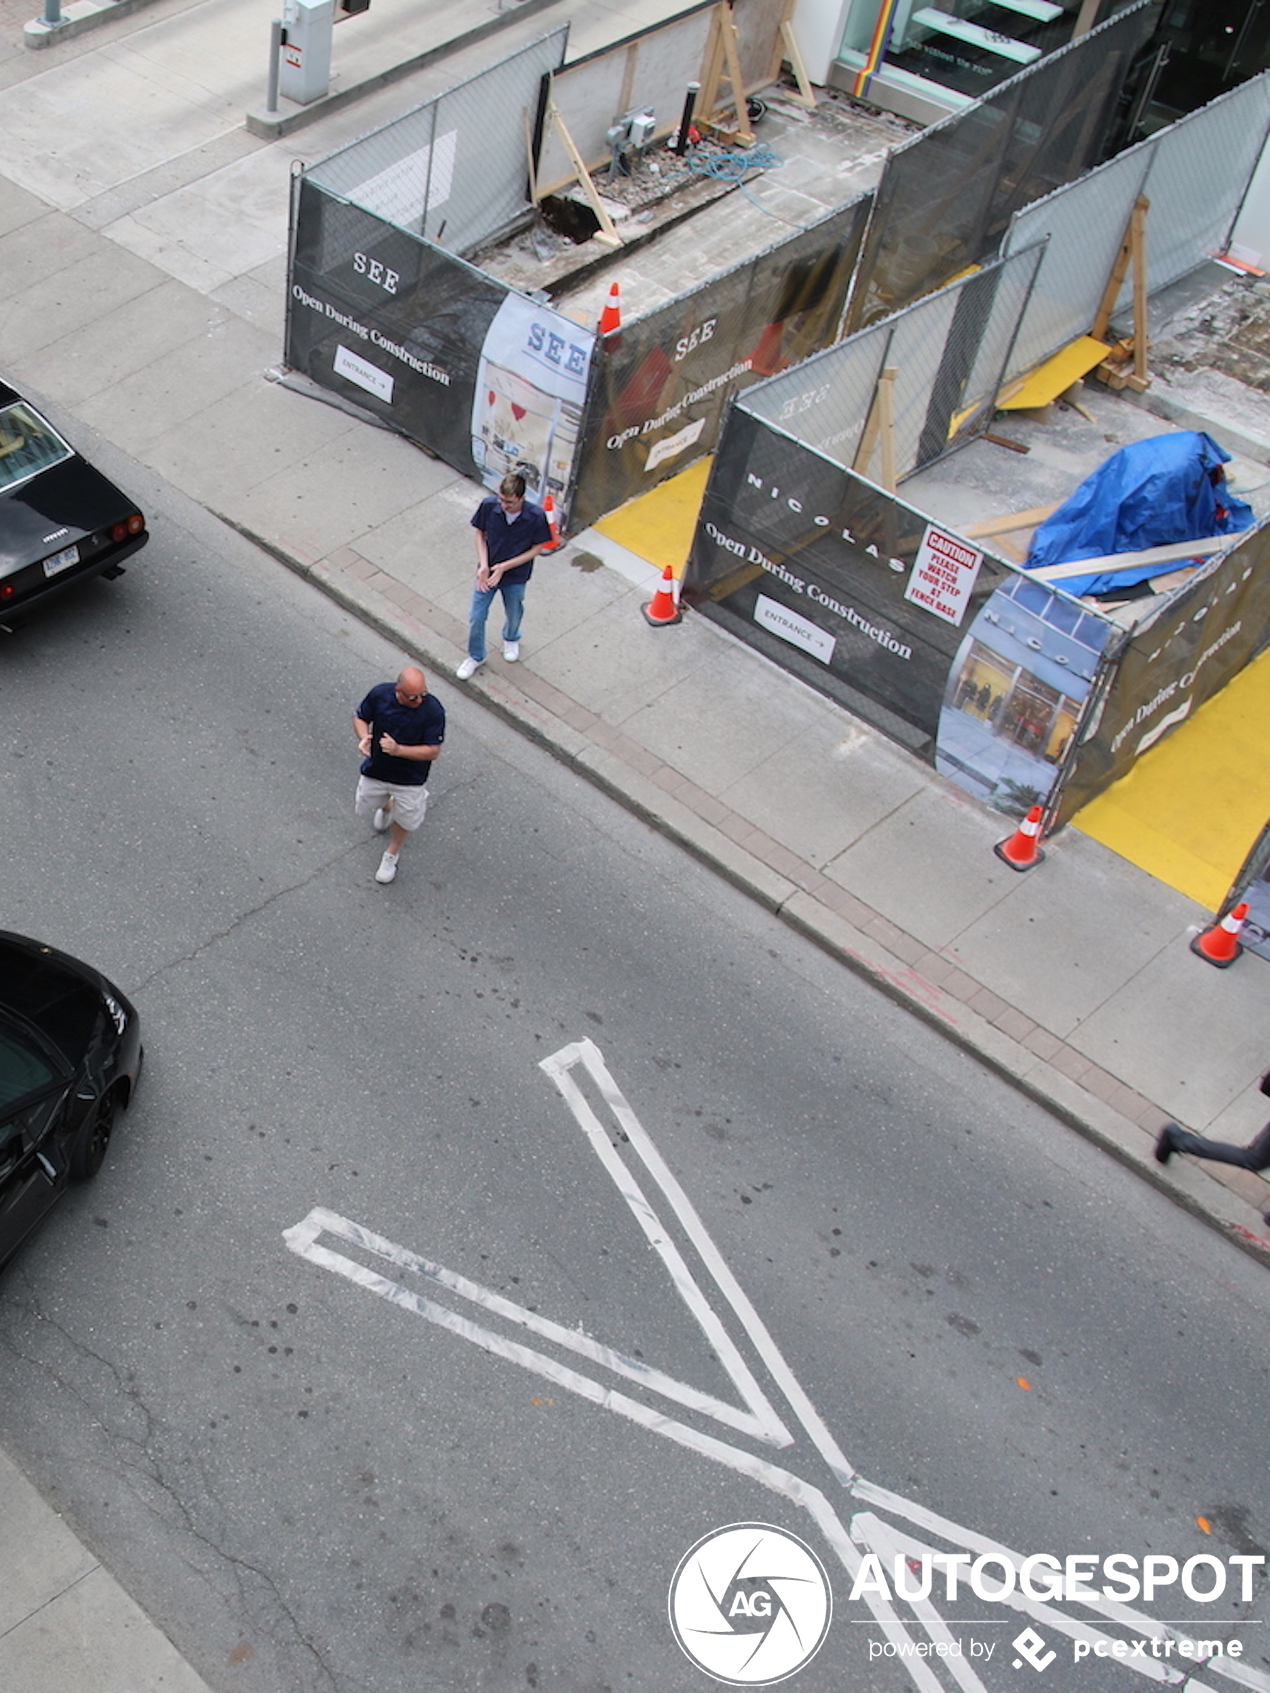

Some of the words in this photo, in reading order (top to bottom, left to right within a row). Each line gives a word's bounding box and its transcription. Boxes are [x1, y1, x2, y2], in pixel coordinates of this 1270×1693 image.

[353, 252, 400, 295] SEE
[292, 284, 324, 314] Open
[325, 303, 369, 340] During
[370, 329, 450, 387] Construction
[528, 322, 587, 376] SEE
[675, 318, 717, 362] SEE
[342, 359, 377, 383] ENTRANCE
[682, 358, 753, 407] Construction
[747, 473, 906, 573] NICOLAS
[928, 533, 975, 566] CAUTION
[931, 553, 960, 575] PLEASE
[919, 569, 941, 587] YOUR
[940, 581, 961, 598] STEP
[927, 562, 958, 585] WATCH
[705, 522, 746, 560] Open
[747, 546, 805, 594] During
[806, 584, 913, 660] Construction
[911, 587, 935, 606] FENCE
[936, 600, 957, 619] BASE
[930, 587, 942, 598] AT
[764, 609, 813, 640] ENTRANCE
